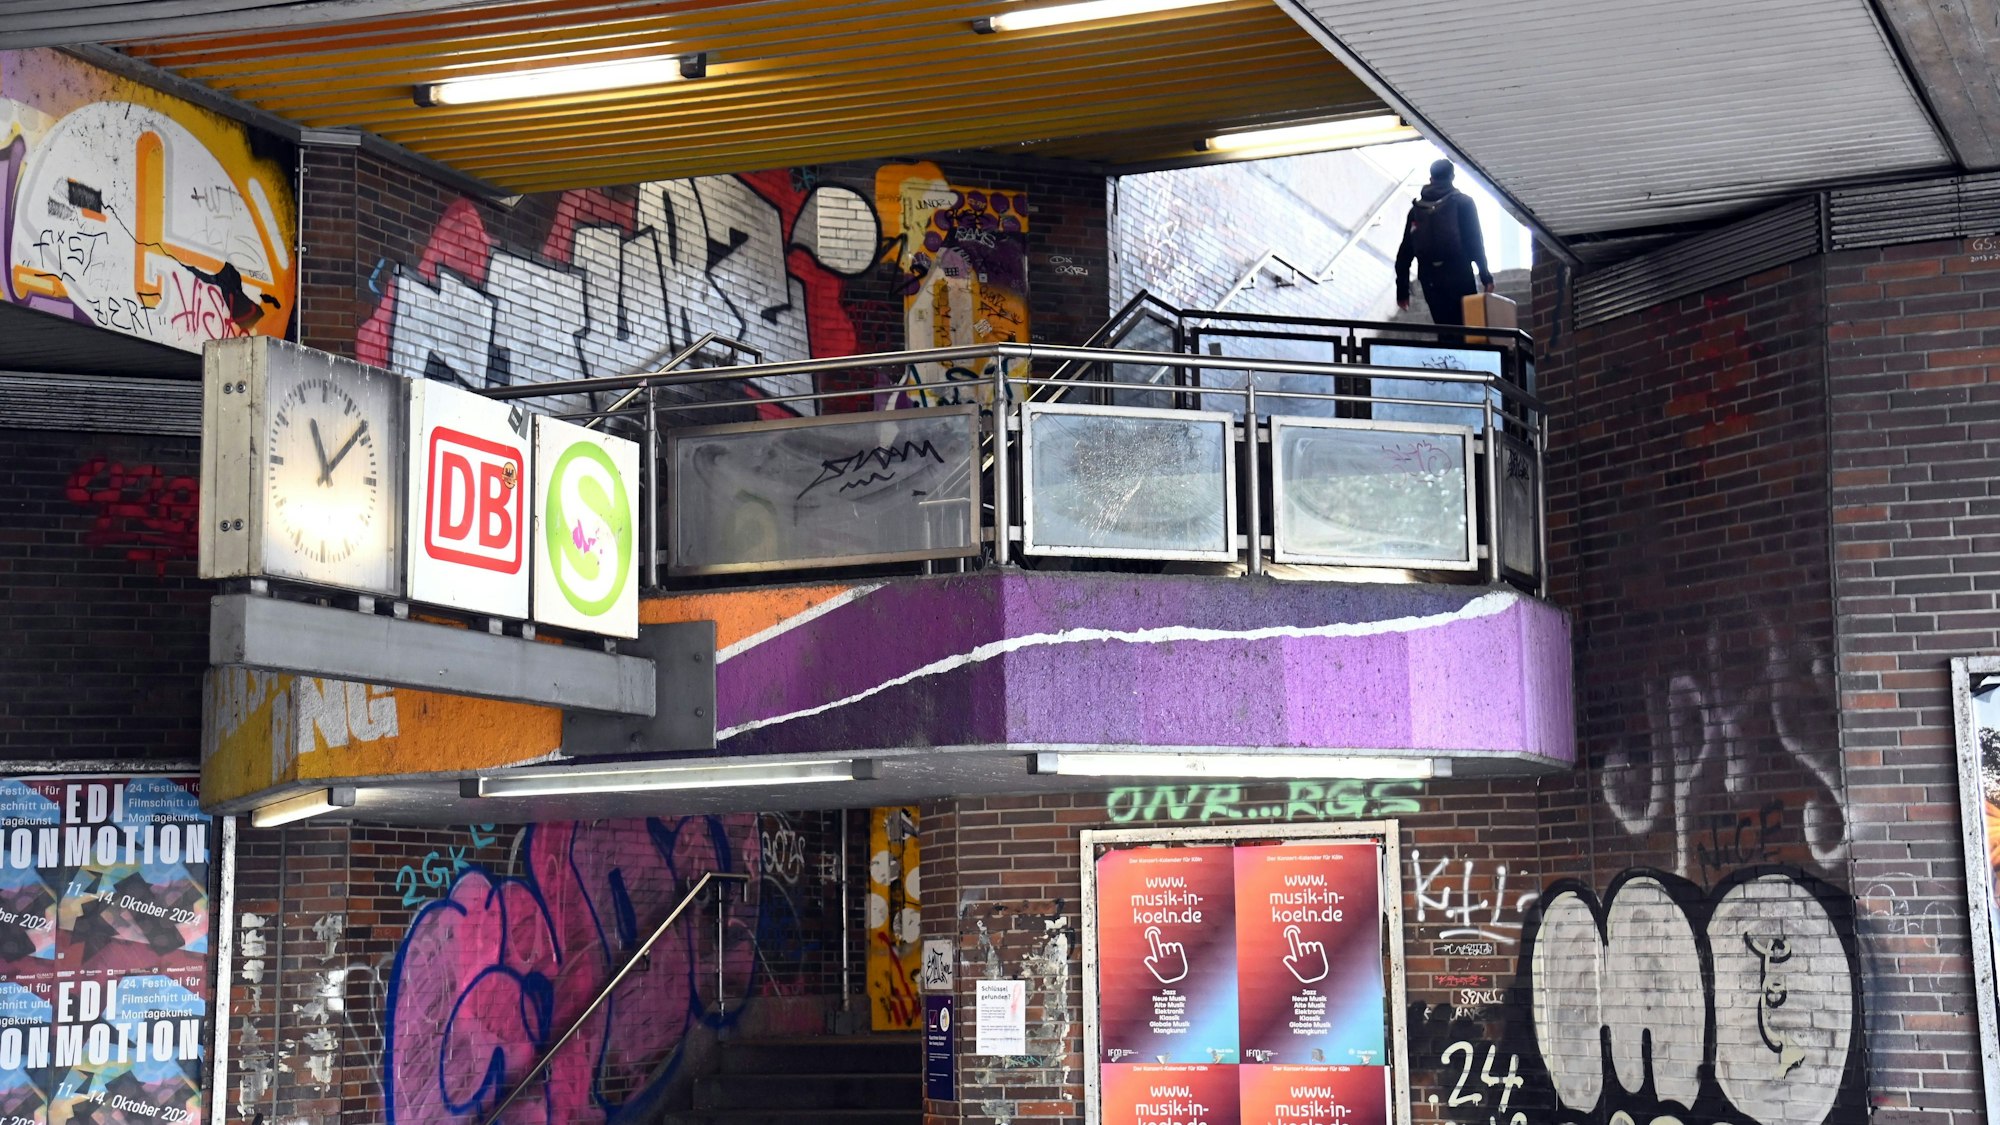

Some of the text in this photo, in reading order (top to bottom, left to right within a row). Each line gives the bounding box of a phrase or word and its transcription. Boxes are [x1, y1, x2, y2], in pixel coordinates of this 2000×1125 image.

[439, 450, 513, 550] DB
[560, 455, 620, 603] S
[45, 786, 60, 795] für
[148, 784, 188, 793] Festival
[191, 783, 201, 792] fü
[40, 801, 59, 810] und
[66, 784, 124, 824] EDI
[128, 798, 184, 808] Filmschnitt
[128, 813, 199, 824] Montagekunst
[64, 823, 206, 867] MOTION
[1145, 877, 1188, 888] www.
[1284, 874, 1328, 887] www.
[1131, 890, 1204, 907] musik-in-
[1269, 888, 1345, 905] musik-in-
[120, 895, 168, 918] Oktober
[169, 908, 202, 927] 2024
[1133, 907, 1202, 924] koeln.de
[1271, 905, 1343, 923] koeln.de
[19, 913, 54, 933] 2024
[36, 983, 52, 993] für
[142, 978, 183, 989] Festival
[186, 976, 201, 987] für
[31, 998, 51, 1009] und
[57, 979, 118, 1023] EDI
[121, 992, 200, 1005] Filmschnitt und
[981, 993, 1011, 1001] gefunden?
[121, 1008, 194, 1021] Montagekunst
[55, 1019, 200, 1068] MOTION
[1150, 1085, 1193, 1098] www.
[1290, 1086, 1334, 1099] www.
[111, 1094, 161, 1118] Oktober
[161, 1105, 195, 1125] 2024
[1135, 1100, 1209, 1116] musik-in-
[1275, 1101, 1351, 1118] musik-in-
